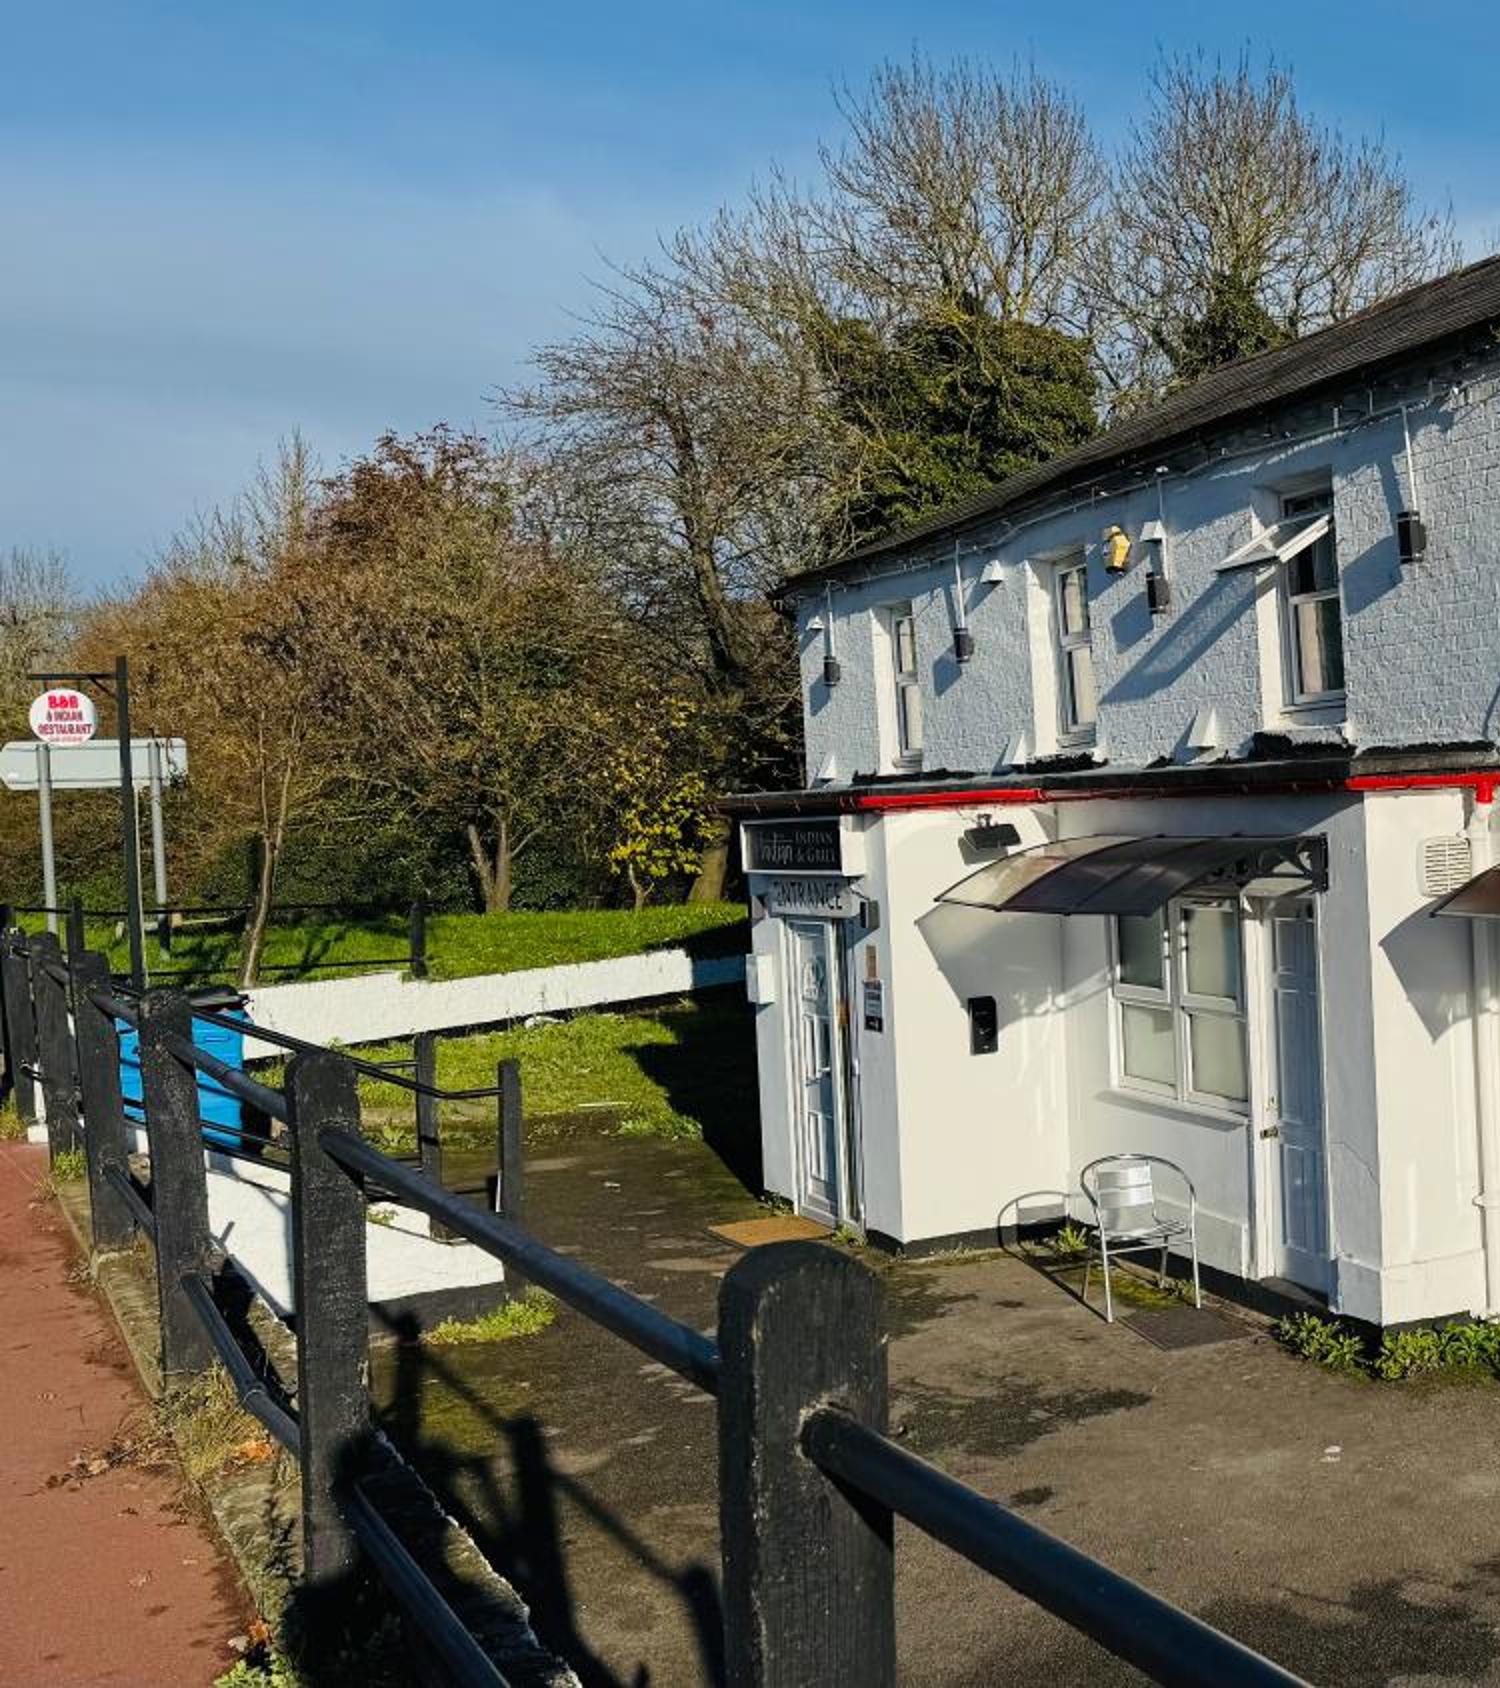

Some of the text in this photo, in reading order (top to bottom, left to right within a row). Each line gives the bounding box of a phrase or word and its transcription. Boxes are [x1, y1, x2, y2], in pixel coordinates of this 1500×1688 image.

[47, 695, 79, 709] B&B
[54, 710, 83, 722] INDIAN
[38, 723, 92, 735] RESTAURANT
[773, 880, 842, 909] ENTRANCE
